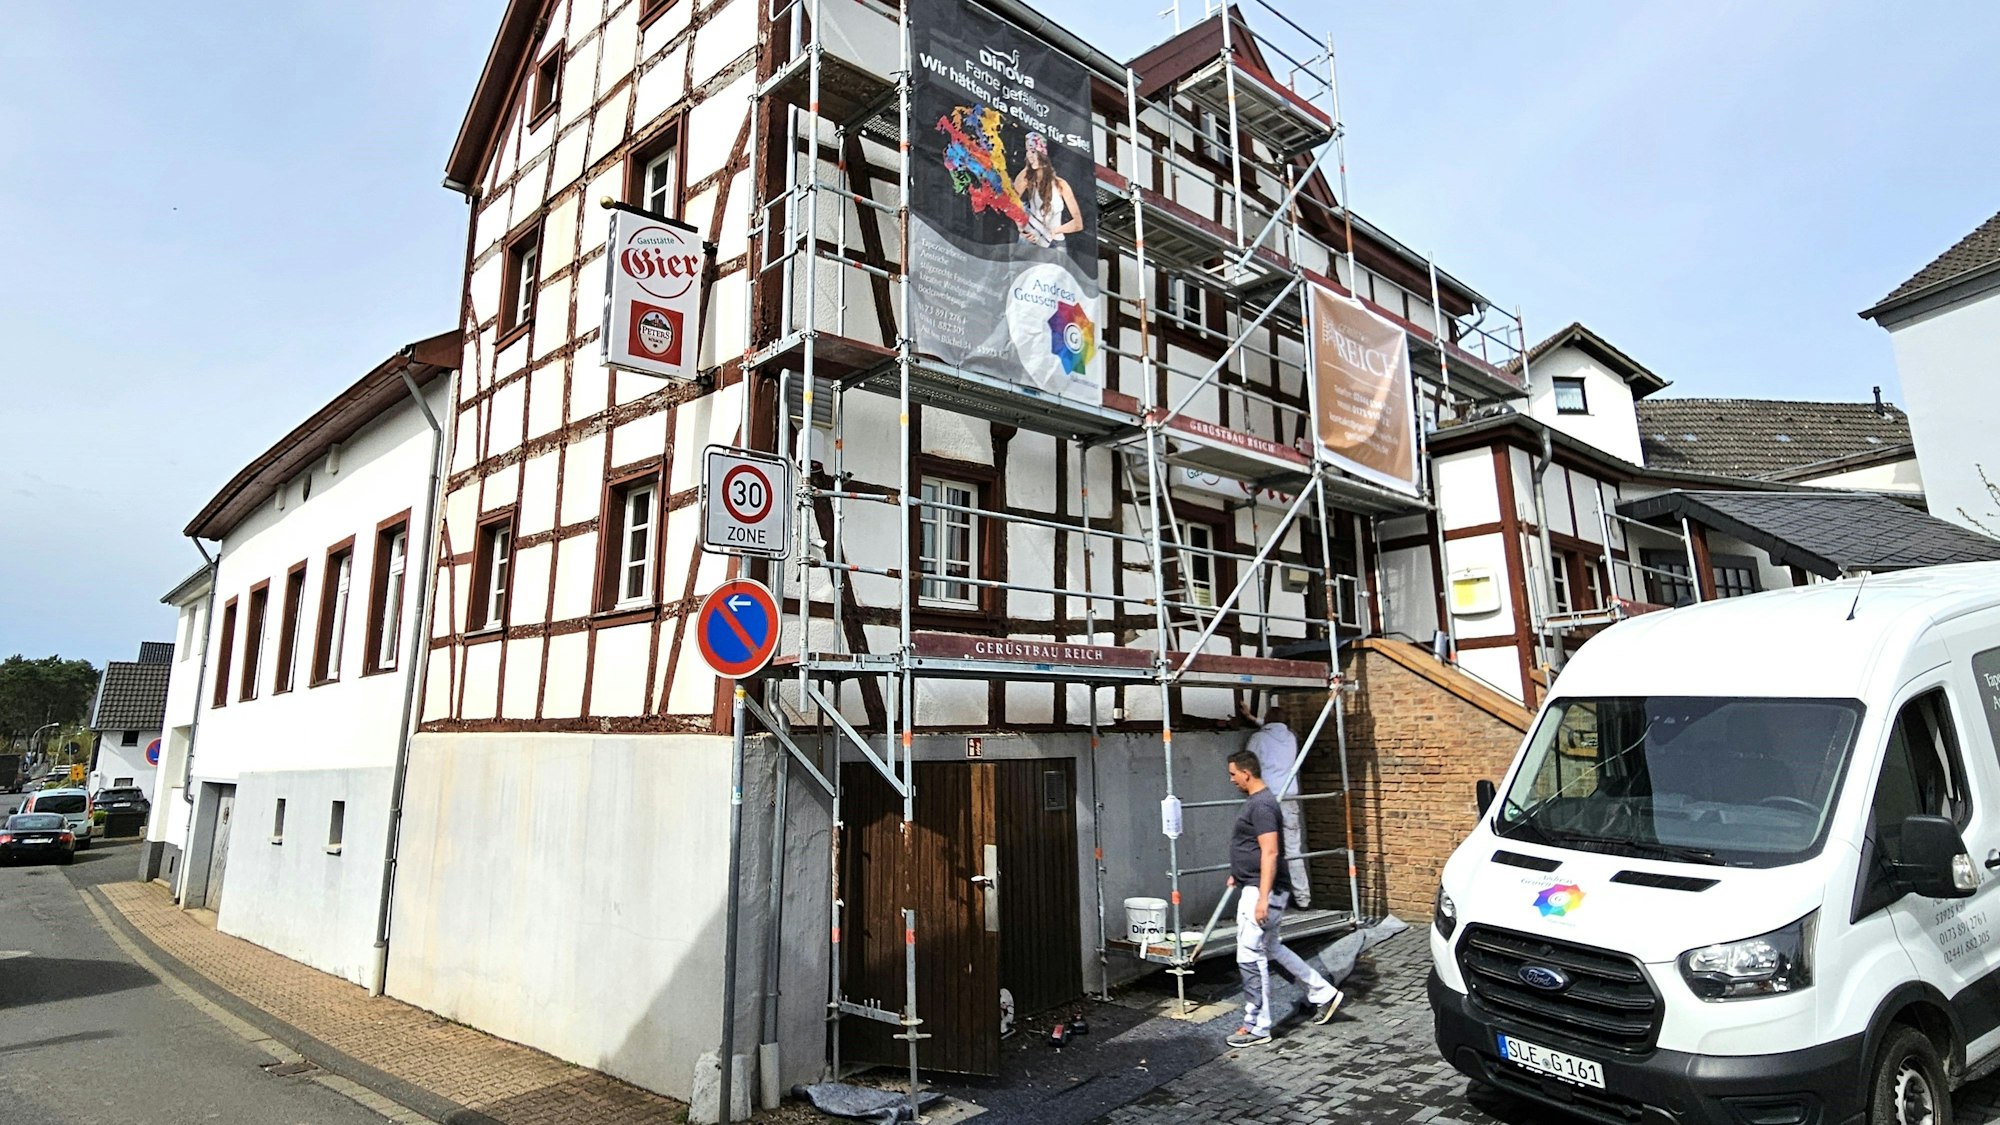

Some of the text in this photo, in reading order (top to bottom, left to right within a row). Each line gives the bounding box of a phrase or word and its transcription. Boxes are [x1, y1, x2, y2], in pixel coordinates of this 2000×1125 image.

[979, 49, 1035, 89] Dinova
[965, 60, 1050, 117] Farbe gefällig?
[919, 53, 1091, 153] Wir hätten da etwas für Sie!
[637, 236, 675, 246] Gaststätte
[620, 247, 699, 280] Gier
[1014, 287, 1056, 309] Geusen
[1033, 279, 1076, 302] Andreas
[642, 325, 671, 340] PETERS
[1069, 332, 1078, 344] G
[1189, 420, 1276, 453] GERÜSTBAU REICH
[732, 479, 762, 509] 30
[727, 526, 767, 544] ZONE
[975, 641, 1103, 660] GERÜSTBAU REICH
[1940, 911, 1987, 945] 0173 891 2761
[1943, 930, 1990, 965] 02441 882 305
[1526, 968, 1551, 987] Ford
[1508, 1040, 1541, 1066] SLE
